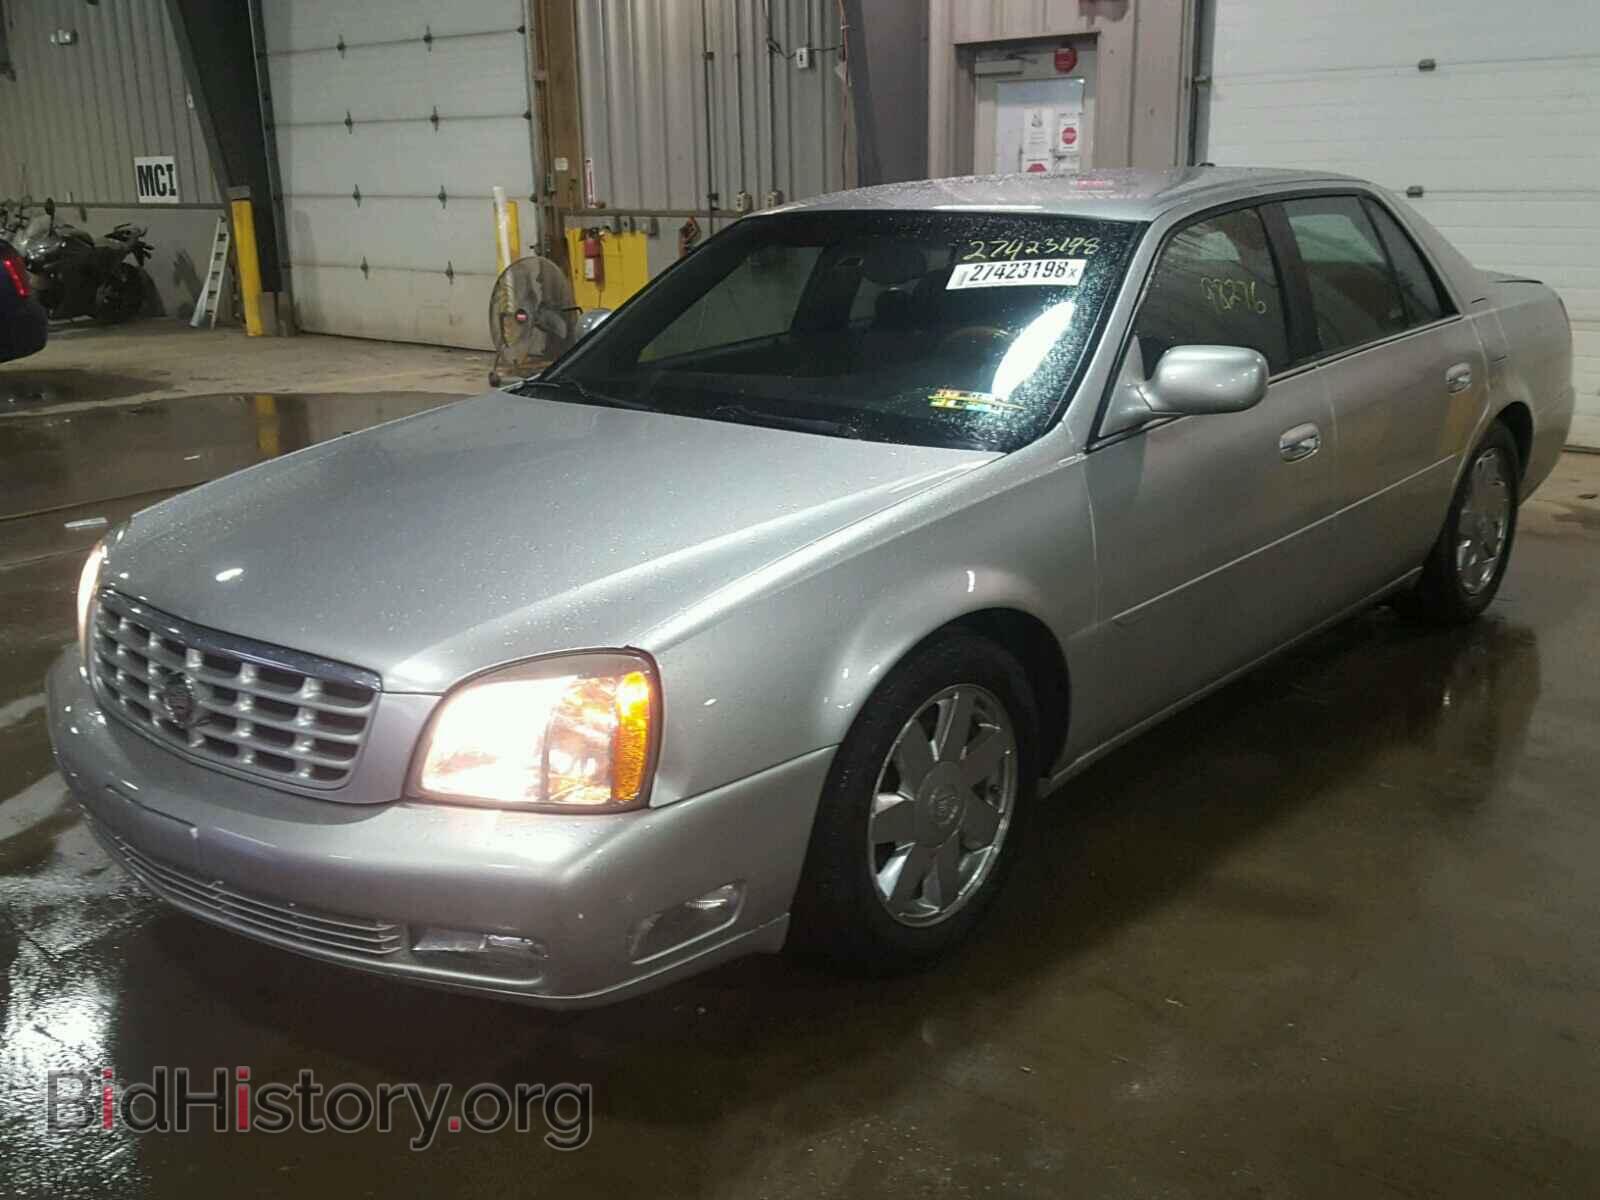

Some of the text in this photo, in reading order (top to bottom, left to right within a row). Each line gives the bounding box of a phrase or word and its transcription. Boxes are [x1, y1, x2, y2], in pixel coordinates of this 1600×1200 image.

[137, 164, 177, 196] MCI
[962, 237, 1101, 260] 27423198
[969, 260, 1068, 282] 27423198
